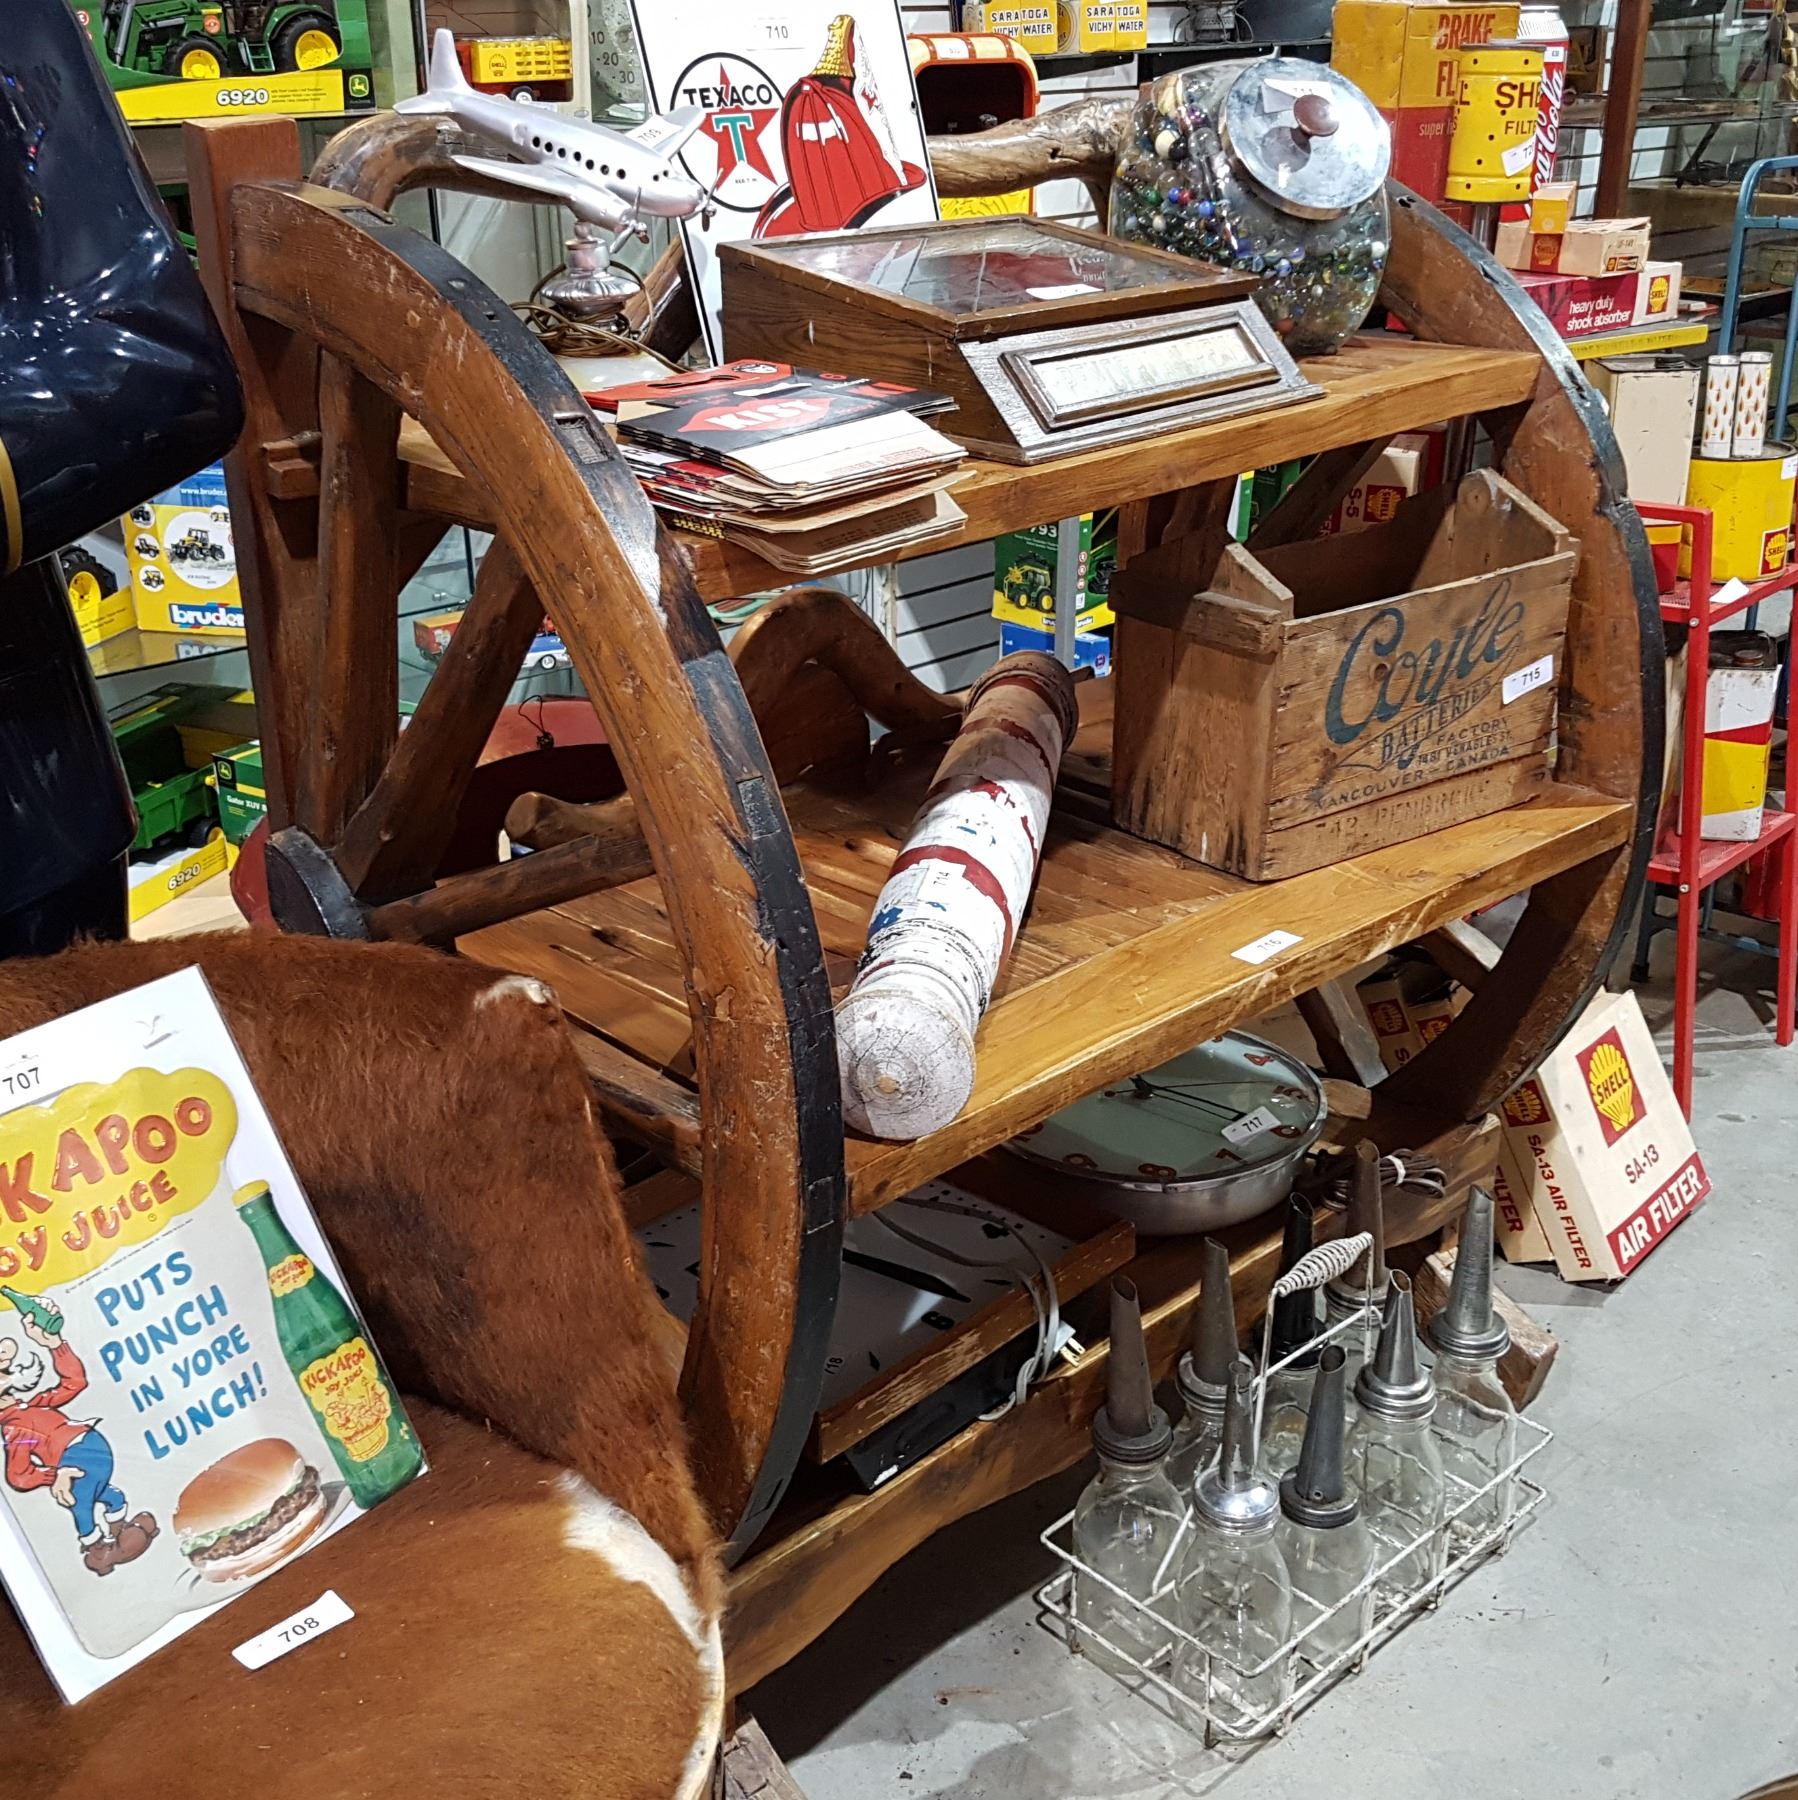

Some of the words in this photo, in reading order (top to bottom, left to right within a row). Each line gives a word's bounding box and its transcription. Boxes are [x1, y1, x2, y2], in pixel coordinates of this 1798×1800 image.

[991, 7, 1048, 23] SARATOGA
[1086, 6, 1140, 17] SARATOGA
[1088, 21, 1113, 32] VICHY
[1117, 21, 1144, 32] WATER
[765, 25, 789, 39] 710
[1022, 23, 1053, 35] WATER
[1436, 13, 1496, 50] BRAKE
[216, 88, 269, 106] 6920
[682, 83, 773, 109] TEXACO
[712, 113, 755, 165] T
[1418, 122, 1443, 139] super
[1566, 313, 1592, 332] shock
[1593, 309, 1632, 327] absorber
[1568, 299, 1594, 315] heavy
[1595, 296, 1615, 310] duty
[704, 398, 822, 431] KIST
[1346, 487, 1362, 518] S-5
[1379, 488, 1393, 518] SHELL
[1325, 577, 1526, 769] Coyle
[1521, 667, 1542, 686] 715
[1382, 675, 1493, 765] BATTERIES
[1437, 716, 1512, 746] FACTORY
[1313, 770, 1424, 810] VANCOUVER
[1446, 745, 1511, 772] CANADA
[168, 863, 201, 890] 6920
[2, 1067, 42, 1095] 707
[1596, 1066, 1629, 1105] SHELL
[1241, 1116, 1265, 1133] 717
[1625, 1143, 1660, 1184] SA-13
[62, 1169, 179, 1251] JUICE
[1528, 1133, 1555, 1181] SA-13
[1546, 1184, 1568, 1211] AIR
[1560, 1214, 1593, 1269] FILTER
[1616, 1213, 1653, 1266] AIR
[1647, 1164, 1703, 1233] FILTER
[94, 1250, 193, 1327] PUTS
[99, 1285, 229, 1383] PUNCH
[130, 1375, 165, 1413] IN
[171, 1323, 250, 1389] YORE
[303, 1347, 367, 1392] KICKAPOO
[324, 1379, 341, 1397] JOY
[143, 1360, 268, 1461] LUNCH!
[277, 1616, 320, 1643] 708
